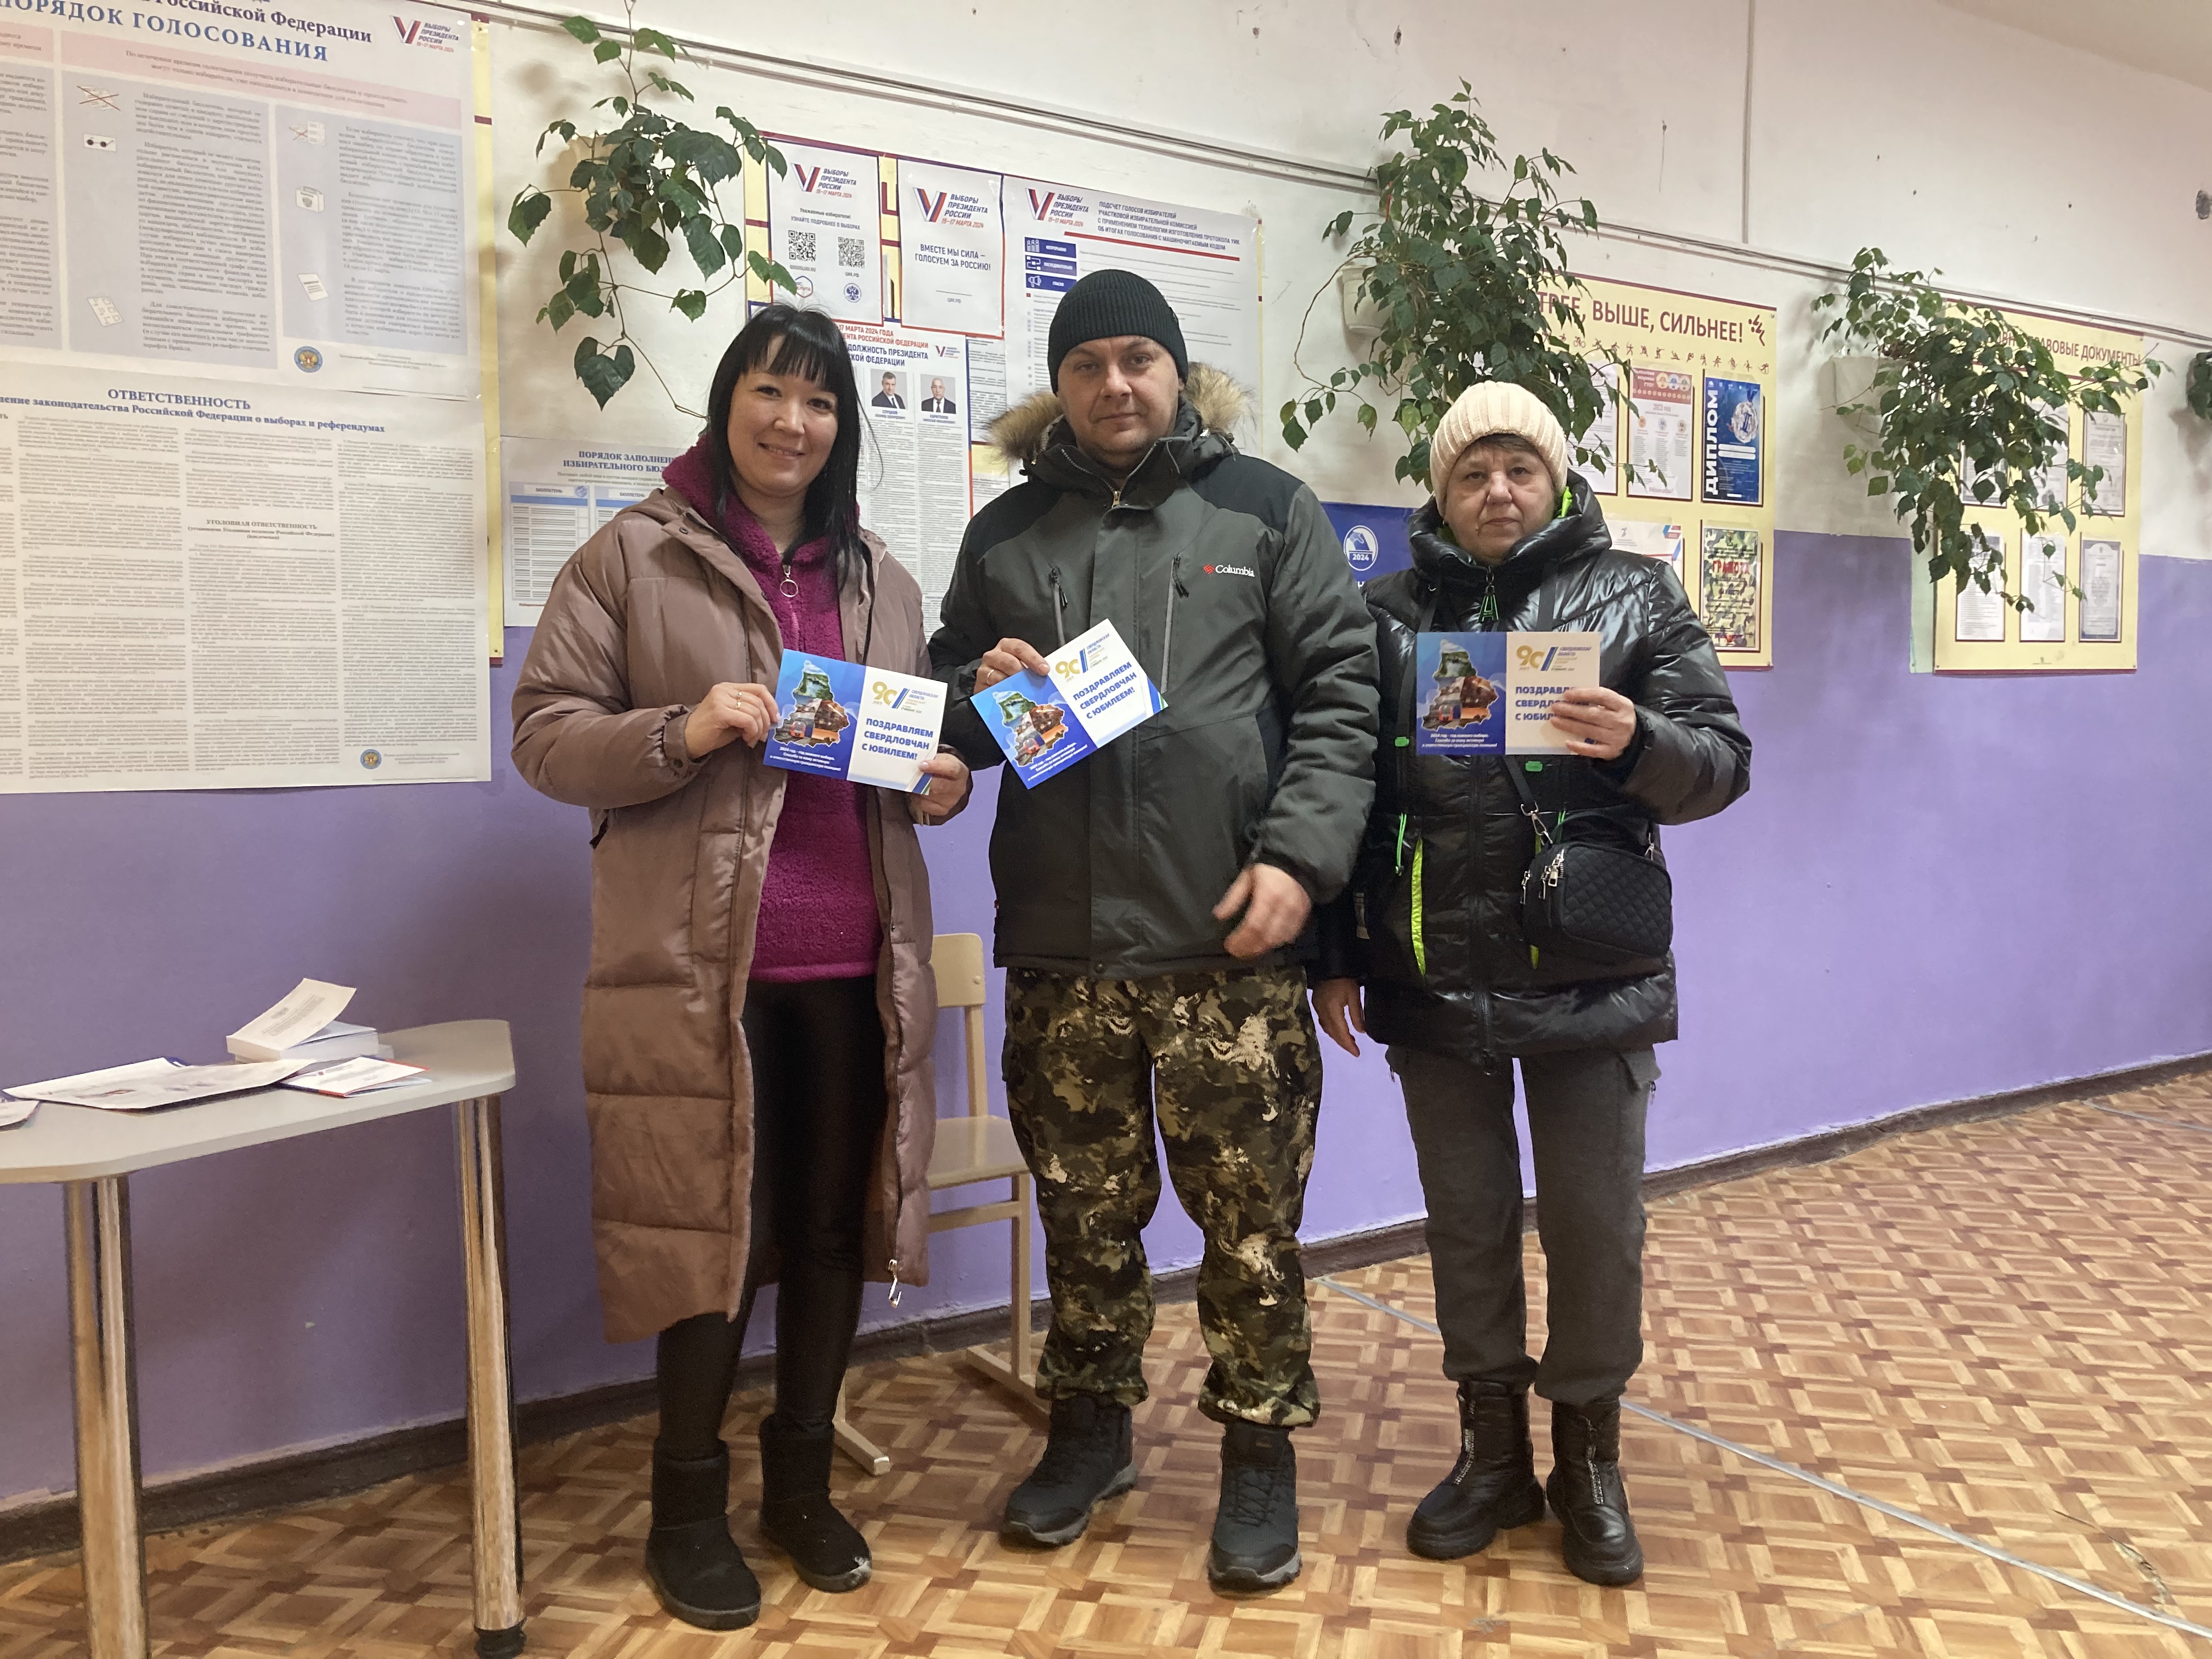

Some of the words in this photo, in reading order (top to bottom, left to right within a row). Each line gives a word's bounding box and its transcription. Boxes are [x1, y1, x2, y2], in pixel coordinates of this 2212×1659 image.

[154, 0, 265, 22] оссийской
[270, 10, 372, 43] Федерации
[424, 23, 451, 32] ВЫБОРЫ
[132, 12, 328, 61] ГОЛОСОВАНИЯ
[418, 36, 443, 44] РОССИИ
[421, 29, 459, 41] ПРЕЗИДЕНТА
[823, 168, 849, 177] ВЫБОРЫ
[818, 182, 842, 190] РОССИИ
[821, 175, 856, 185] ПРЕЗИДЕНТА
[950, 194, 979, 204] ВЫБОРЫ
[1057, 194, 1083, 203] ВЫБОРЫ
[947, 201, 988, 213] ПРЕЗИДЕНТА
[1050, 209, 1074, 218] РОССИИ
[1053, 201, 1089, 212] ПРЕЗИДЕНТА
[1099, 201, 1121, 210] ПОДСЧЕТ
[1122, 205, 1143, 213] ГОЛОСОВ
[1144, 208, 1177, 219] ИЗБИРАТЕЛЕЙ
[944, 210, 972, 219] РОССИИ
[1098, 210, 1129, 219] УЧАСТКОВОЙ
[1130, 214, 1169, 225] ИЗБИРАТЕЛЬНОЙ
[1170, 221, 1197, 230] КОМИССИЕЙ
[810, 218, 836, 227] ПОДРОБНЕЕ
[1102, 218, 1137, 229] ПРИМЕНЕНИЕМ
[1138, 224, 1167, 233] ТЕХНОЛОГИИ
[1168, 229, 1203, 239] ИЗГОТОВЛЕНИЯ
[1203, 234, 1230, 243] ПРОТОКОЛА
[1124, 229, 1158, 240] ГОЛОСОВАНИЯ
[1163, 236, 1209, 248] МАШИНОЧИТАЕМЫМ
[920, 244, 945, 255] ВМЕСТЕ
[947, 248, 959, 256] МЫ
[961, 250, 979, 259] СИЛА
[915, 253, 949, 266] ГОЛОСУЕМ
[961, 260, 991, 271] РОССИЮ!
[1593, 300, 1654, 333] ВЫШЕ,
[1660, 311, 1743, 343] СИЛЬНЕЕ!
[858, 334, 894, 345] РОССИЙСКОЙ
[895, 339, 928, 348] ФЕДЕРАЦИИ
[848, 344, 887, 355] ДОЛЖНОСТЬ
[888, 348, 928, 359] ПРЕЗИДЕНТА
[2081, 345, 2140, 366] ДОКУМЕНТЫ
[866, 356, 905, 366] ФЕДЕРАЦИИ
[108, 389, 251, 410] ОТВЕТСТВЕННОСТЬ
[32, 399, 129, 413] законодательства
[132, 405, 193, 417] Российской
[196, 410, 252, 423] Федерации
[264, 415, 306, 427] выборах
[318, 420, 385, 433] референдумах
[1706, 390, 1718, 495] ДИПЛОМ
[579, 451, 622, 460] ПОРЯДОК
[624, 454, 674, 464] ЗАПОЛНЕН
[563, 460, 644, 471] ИЗБИРАТЕЛЬНОГО
[251, 521, 317, 530] ОТВЕТСТВЕННОСТЬ
[1215, 565, 1255, 577] Columbia
[1712, 560, 1750, 574] ГРАМОТА
[1073, 662, 1132, 701] ПОЗДРАВЛЯЕМ
[1080, 672, 1137, 709] СВЕРДЛОВЧАН
[1515, 686, 1572, 695] ПОЗДРАВЛ
[1092, 686, 1135, 715] ЮБИЛЕЕМ!
[866, 718, 933, 737] ПОЗДРАВЛЯЕМ
[864, 731, 929, 749] СВЕРДЛОВЧАН
[868, 744, 917, 760] ЮБИЛЕЕМ!
